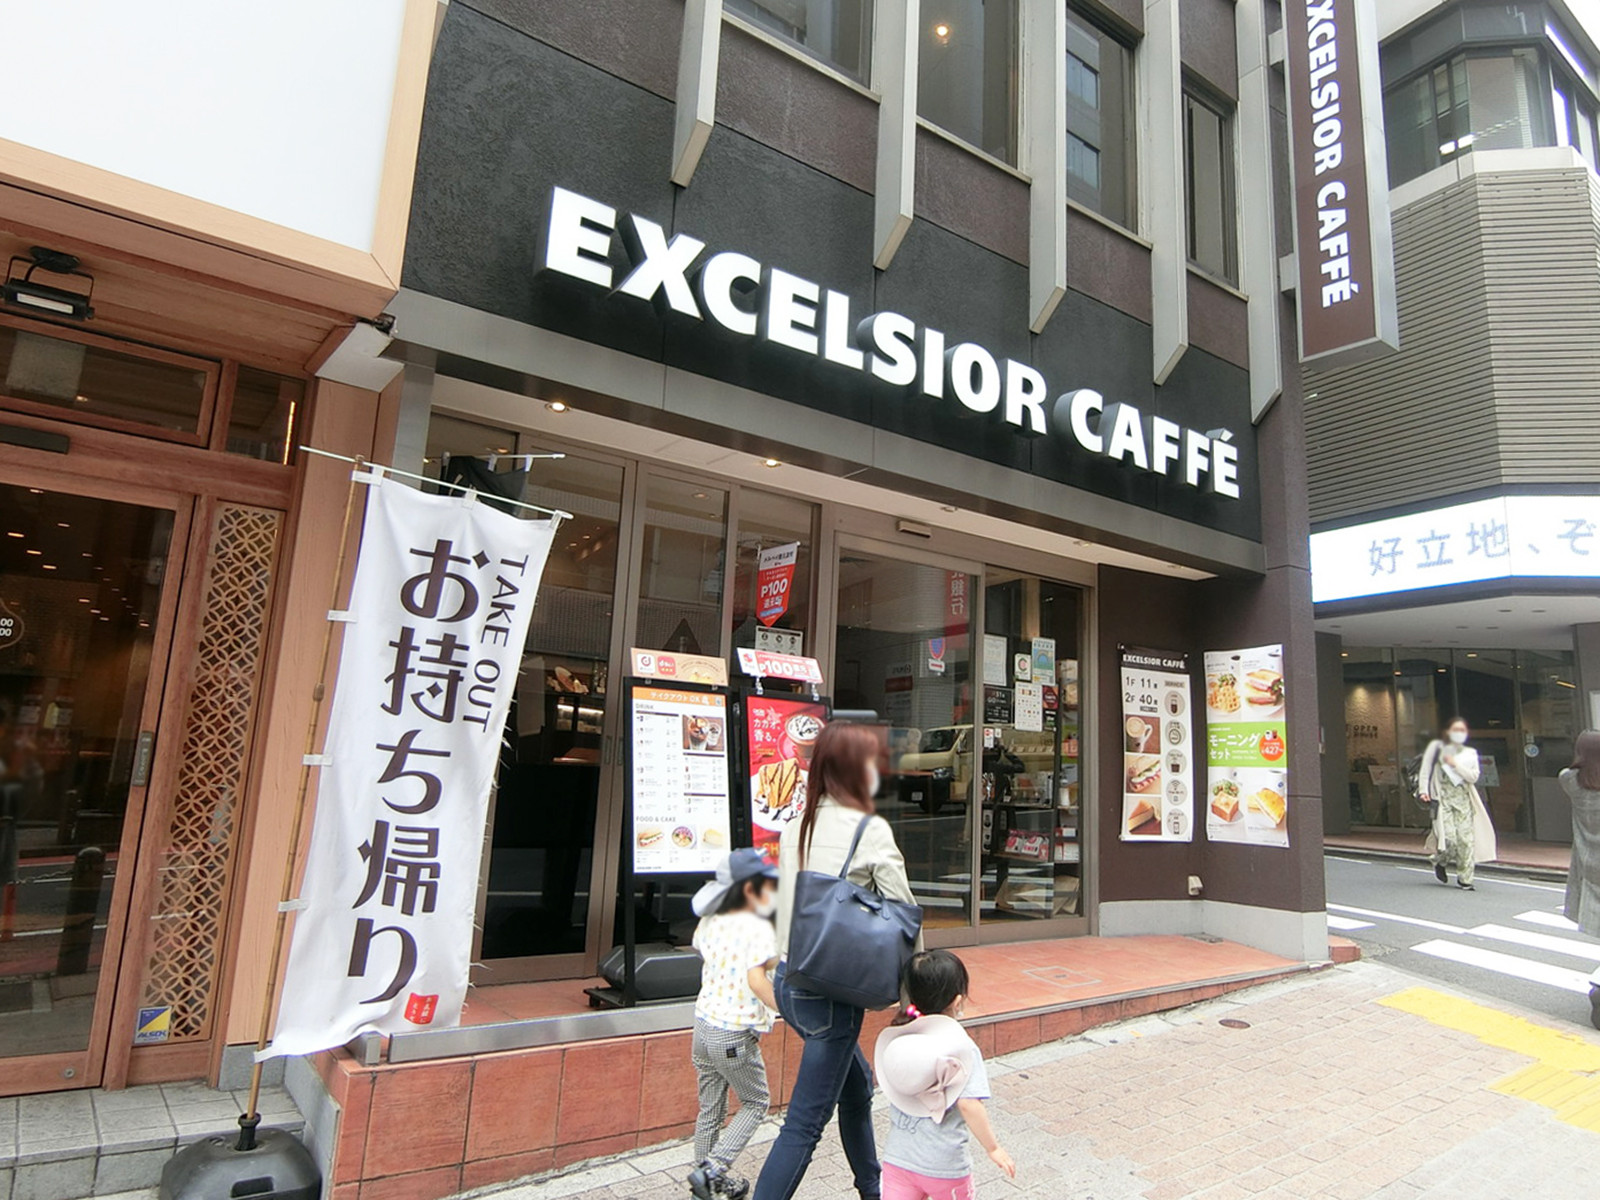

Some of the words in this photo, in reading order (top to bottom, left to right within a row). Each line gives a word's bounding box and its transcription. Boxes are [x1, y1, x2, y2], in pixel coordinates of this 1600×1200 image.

[1306, 0, 1343, 176] XCELSIOR
[1317, 181, 1360, 309] CAFFÉ
[545, 185, 1048, 435] EXCELSIOR
[1068, 388, 1240, 499] CAFFÉ
[480, 554, 530, 647] TAKE
[760, 578, 788, 598] P100
[1122, 654, 1161, 666] EXCELSIOR
[1126, 676, 1135, 686] 1F
[462, 659, 501, 732] OUT
[1125, 692, 1135, 702] 2F
[1209, 733, 1261, 748] モーニング
[1210, 748, 1231, 760] セット
[347, 538, 491, 1005] お持ち帰り
